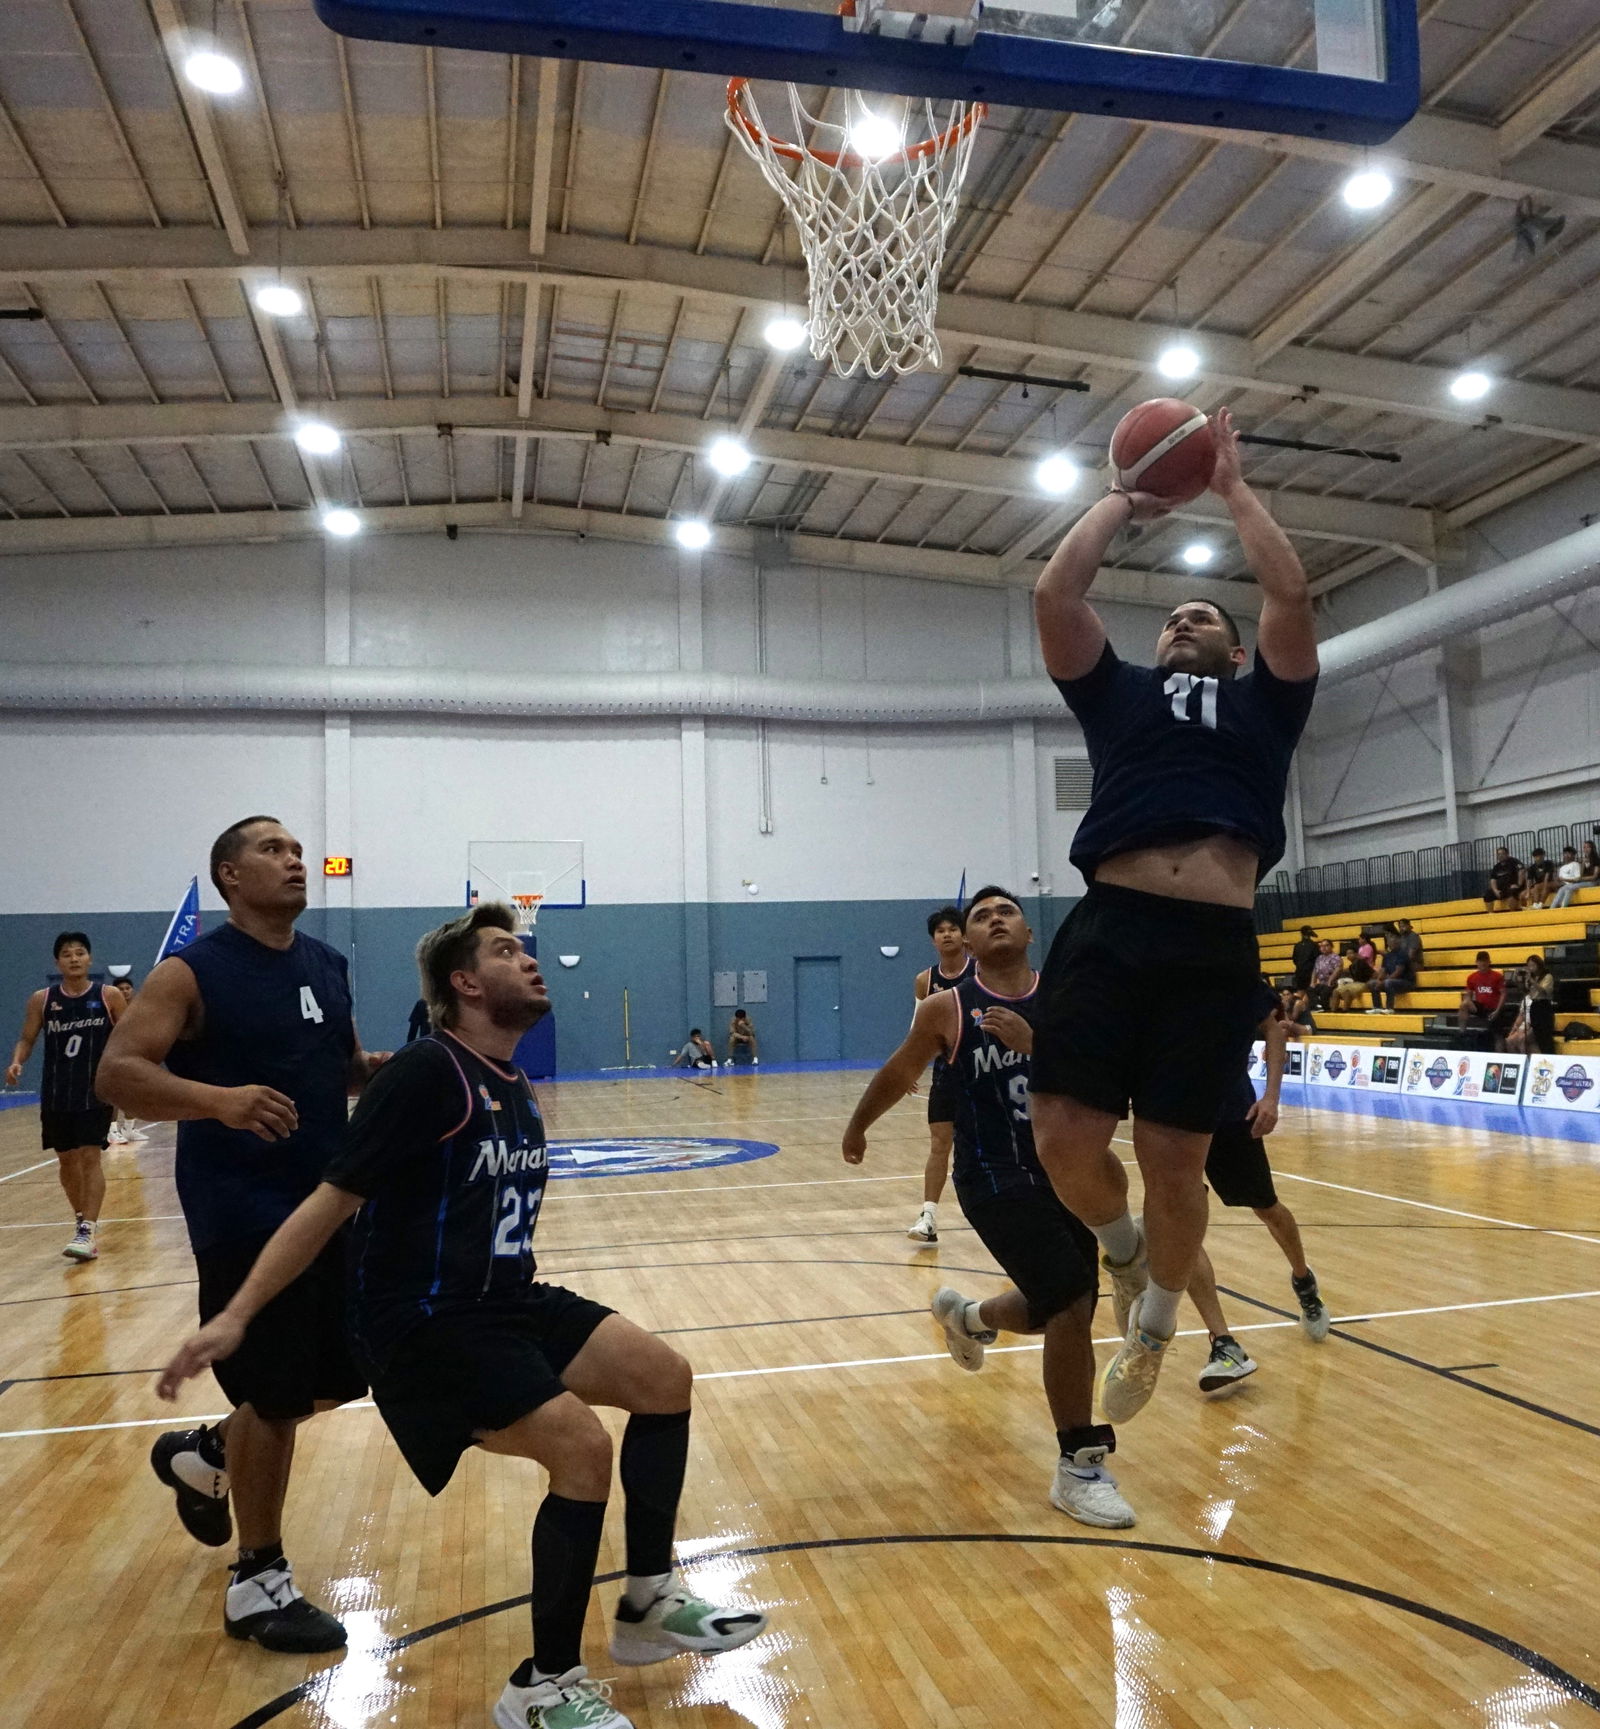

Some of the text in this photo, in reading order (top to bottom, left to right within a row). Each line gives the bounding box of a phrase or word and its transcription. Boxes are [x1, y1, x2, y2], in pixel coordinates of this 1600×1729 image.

[325, 857, 347, 875] 20
[170, 914, 197, 953] TRA
[299, 985, 325, 1025] 4
[47, 1016, 106, 1036] Marianas
[64, 1034, 83, 1058] 0
[1008, 1074, 1031, 1121] 9
